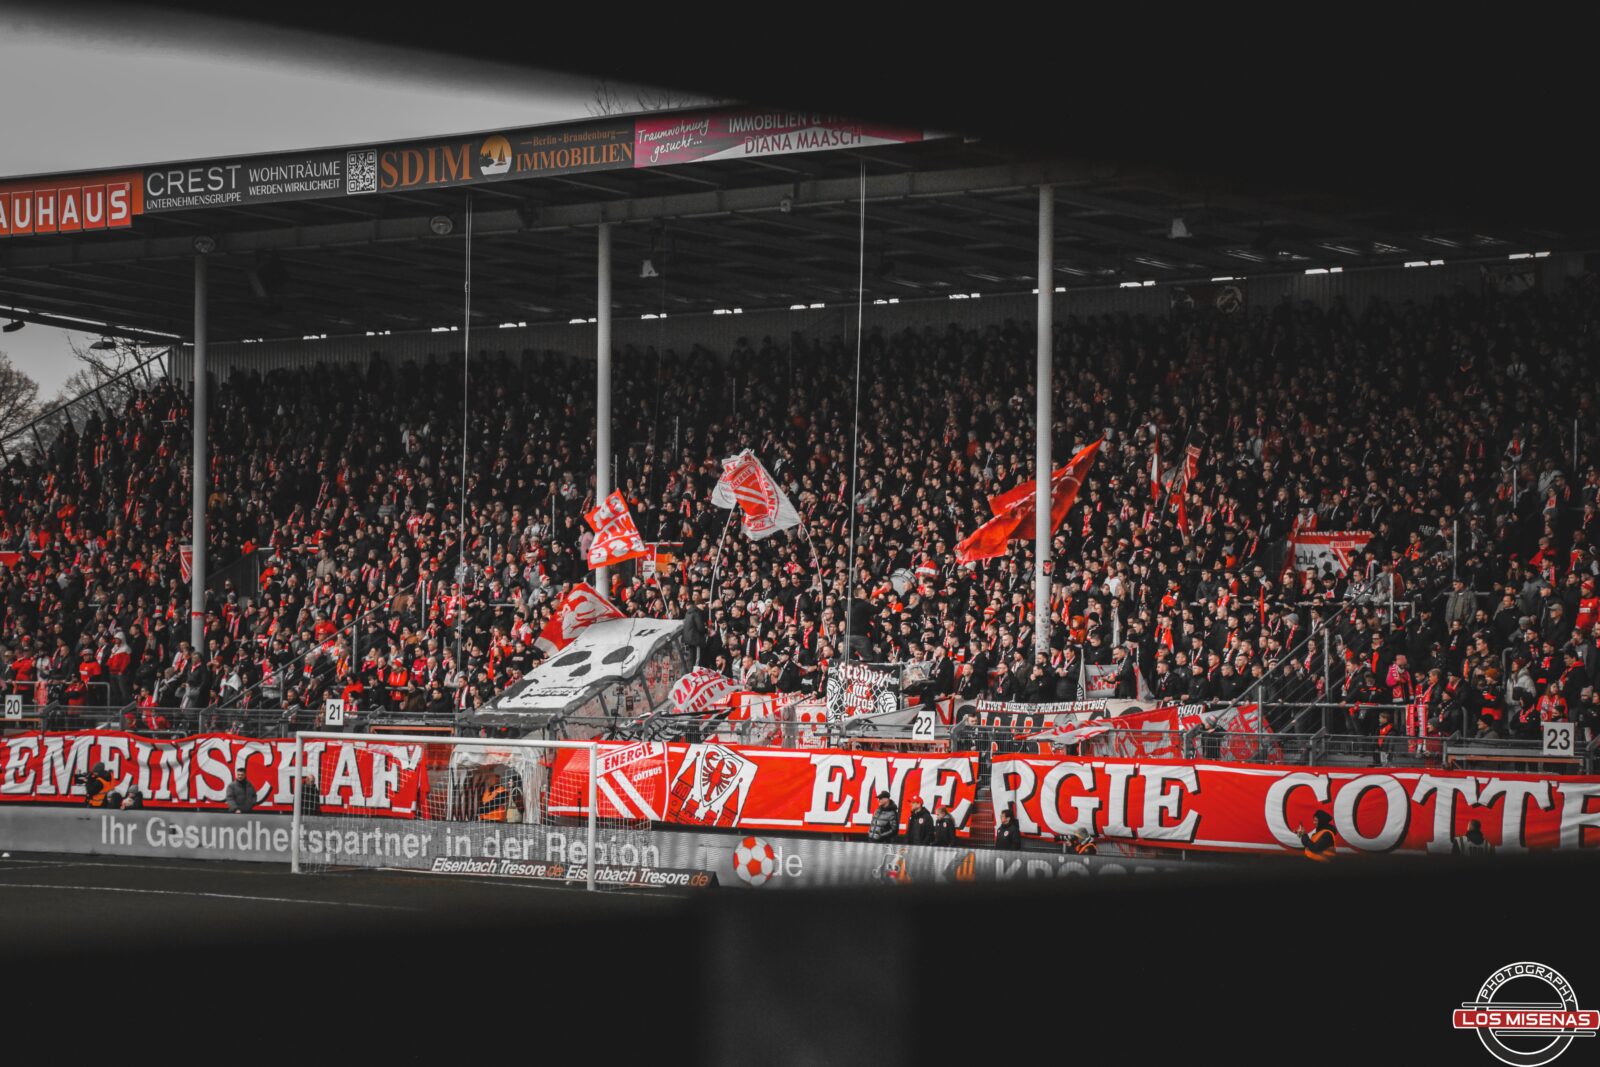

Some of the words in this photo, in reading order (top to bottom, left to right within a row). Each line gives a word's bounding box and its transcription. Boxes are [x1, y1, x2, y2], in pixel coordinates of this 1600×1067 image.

[638, 119, 709, 144] Traumwohnung
[729, 112, 807, 133] IMMOBILIEN
[745, 135, 792, 154] DIANA
[797, 126, 861, 149] MAASCH
[380, 144, 473, 189] SDIM
[516, 142, 633, 173] IMMOBILIEN
[147, 165, 242, 196] CREST
[249, 160, 341, 183] WOHNTRÄUME
[249, 184, 283, 196] WERDEN
[285, 178, 341, 193] WIRKLICHKEIT
[147, 191, 242, 210] UNTERNEHMENSGRUPPE
[1296, 550, 1317, 564] club
[6, 694, 21, 715] 20
[329, 704, 342, 720] 21
[915, 717, 932, 735] 22
[1546, 729, 1571, 751] 23
[604, 742, 653, 771] ENERGIE
[0, 736, 422, 809] EMEINSCHAF
[632, 766, 663, 782] COTTBUS
[102, 815, 137, 846] Ihr
[146, 817, 431, 862] Gesundhetspartner
[446, 827, 471, 857] in
[483, 829, 534, 860] der
[431, 857, 497, 874] Eisenbach
[565, 864, 636, 883] Eisnbach
